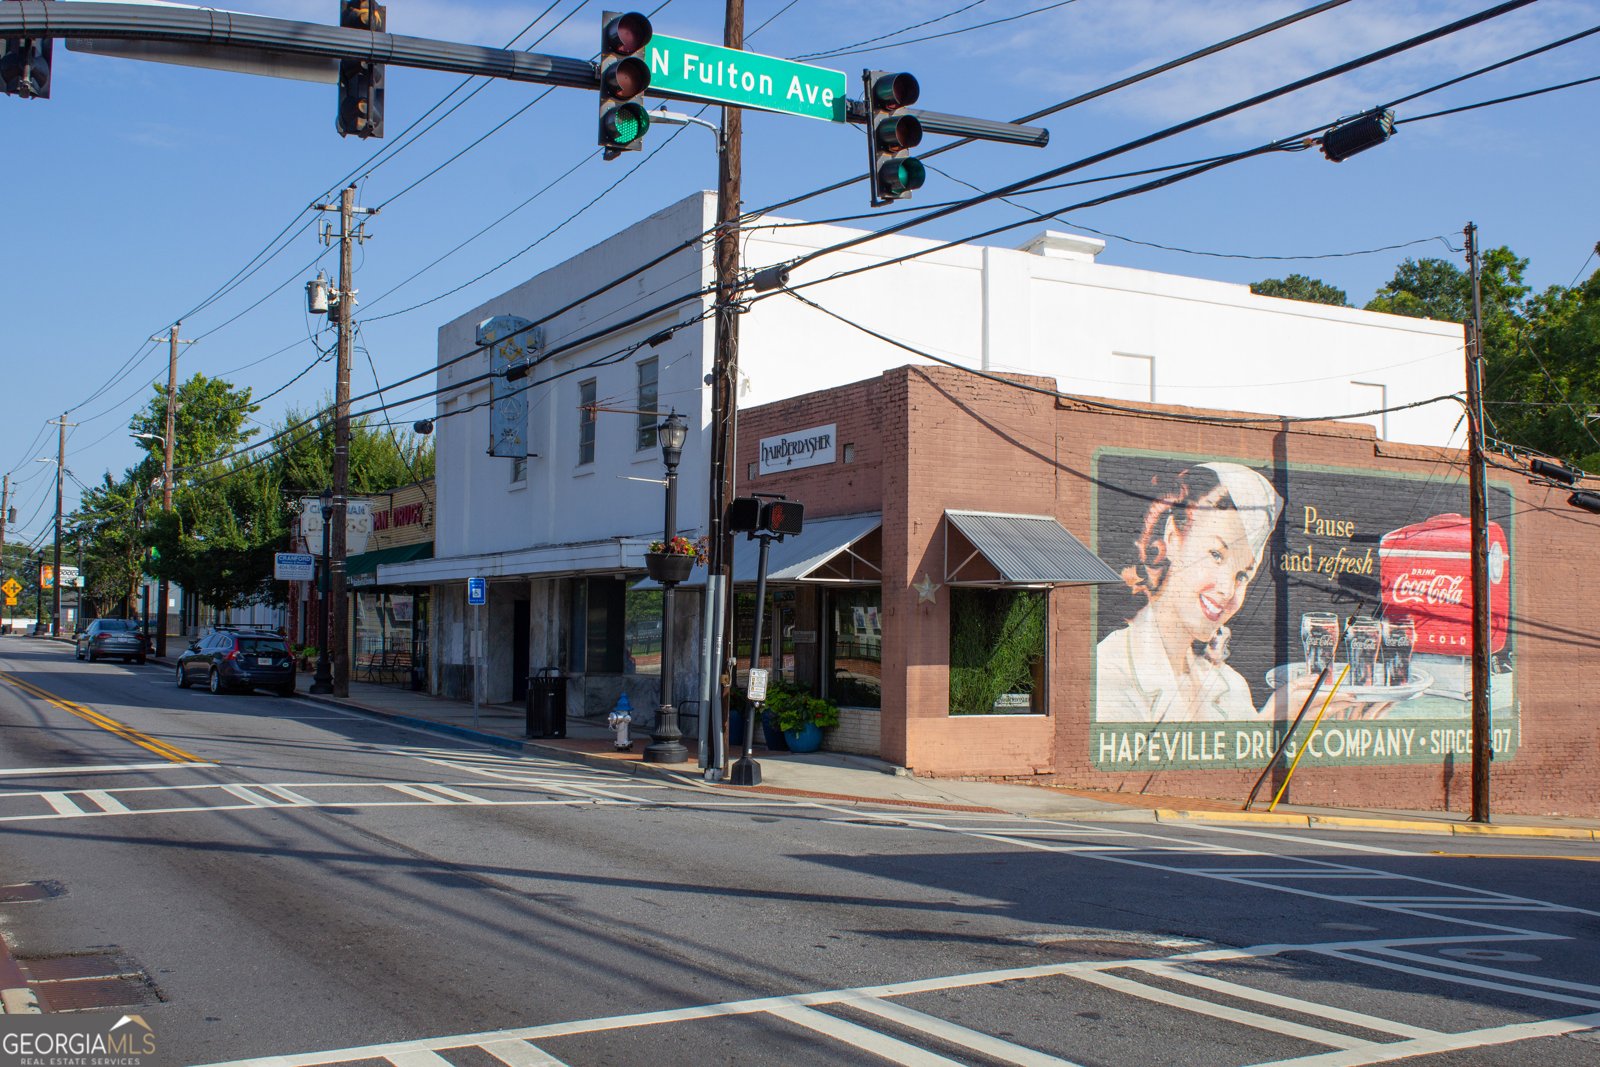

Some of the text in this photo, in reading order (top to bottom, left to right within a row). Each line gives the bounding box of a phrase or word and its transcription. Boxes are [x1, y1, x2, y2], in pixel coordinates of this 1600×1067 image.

[651, 47, 834, 107] N Fulton Ave
[1303, 505, 1355, 538] Pause
[1280, 545, 1373, 581] and refresh
[1411, 568, 1437, 576] DRINK
[1428, 634, 1467, 646] COLD
[1099, 731, 1226, 763] HAPEVILLE
[1236, 729, 1297, 760] DRUG
[1307, 728, 1415, 758] COMPANY
